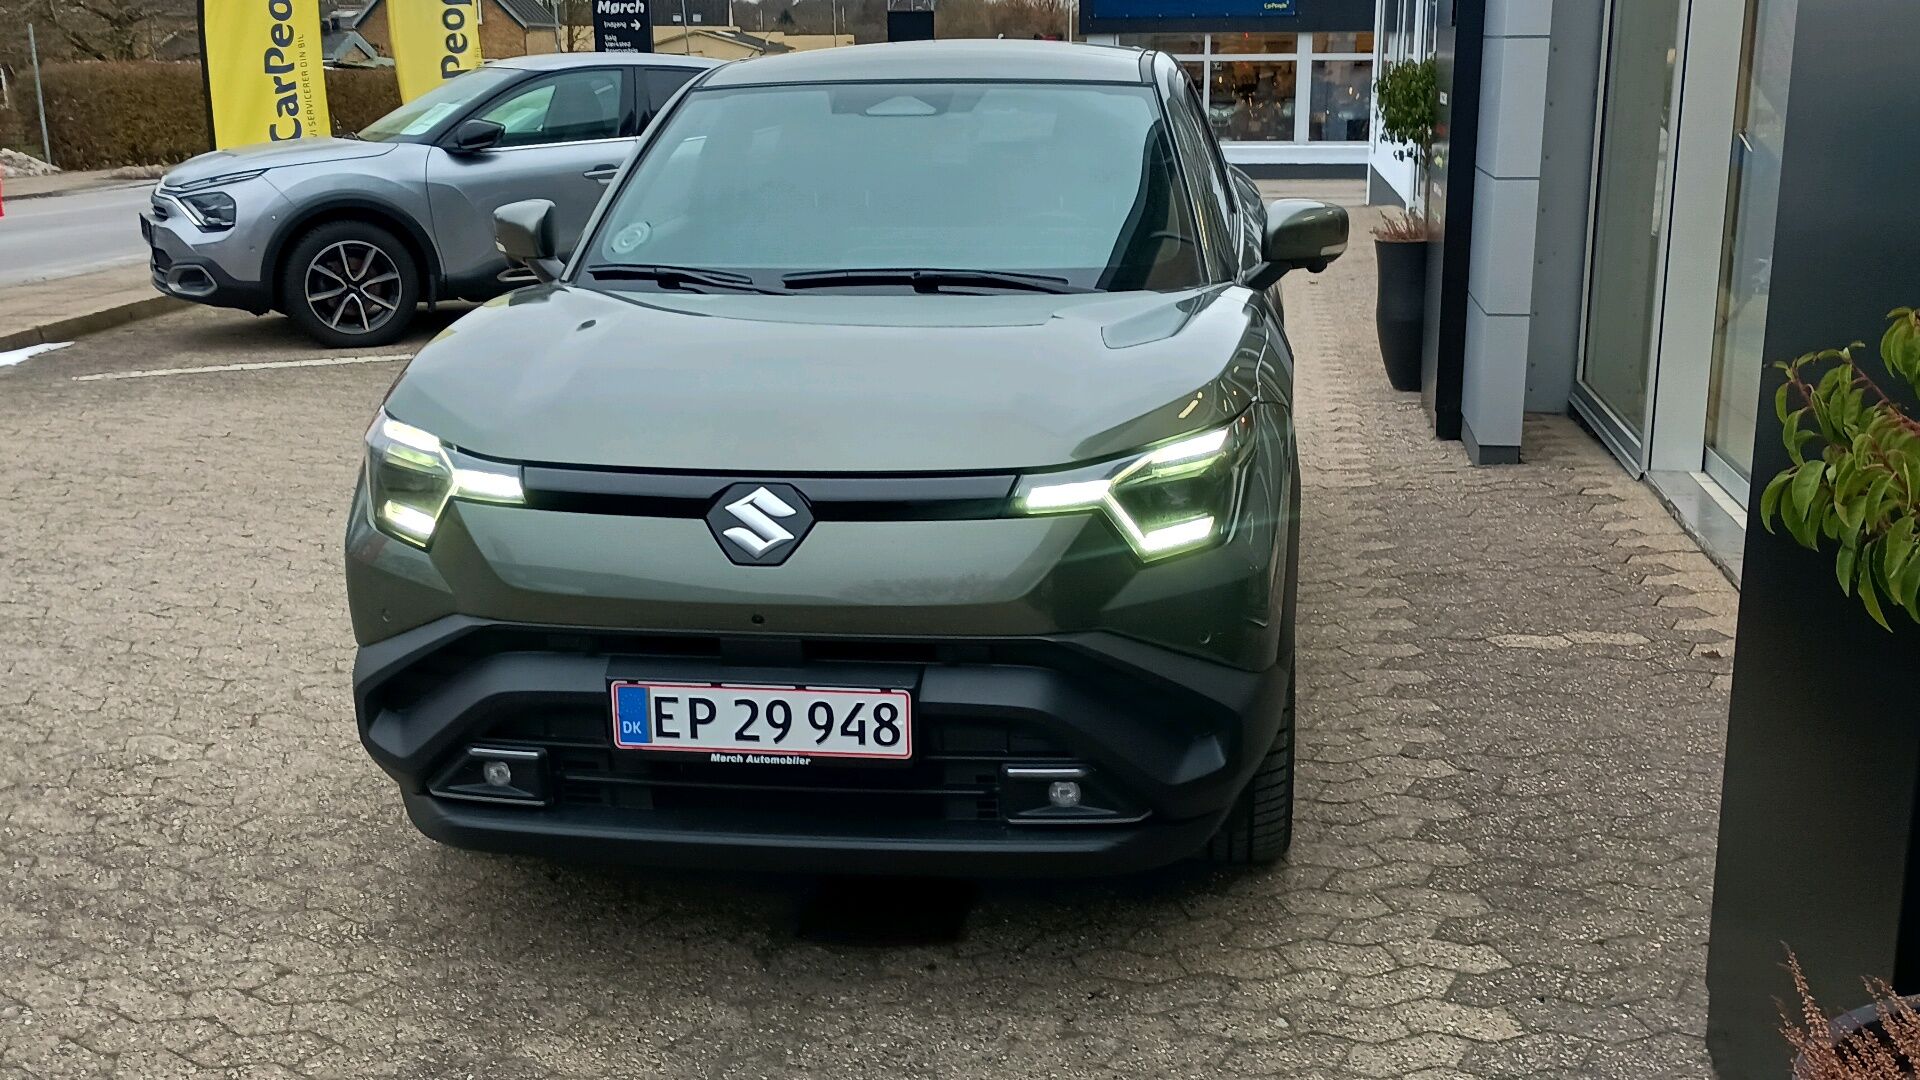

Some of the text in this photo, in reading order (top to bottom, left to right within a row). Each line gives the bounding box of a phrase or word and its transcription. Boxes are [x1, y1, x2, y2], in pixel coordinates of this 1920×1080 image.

[597, 0, 645, 15] Mørch
[297, 33, 306, 49] BIL
[441, 0, 472, 79] Peo
[299, 51, 308, 68] DIN
[301, 70, 316, 127] SERVICERER
[622, 721, 642, 734] DK
[655, 696, 901, 747] EP 29 948
[745, 754, 811, 765] Automobiler
